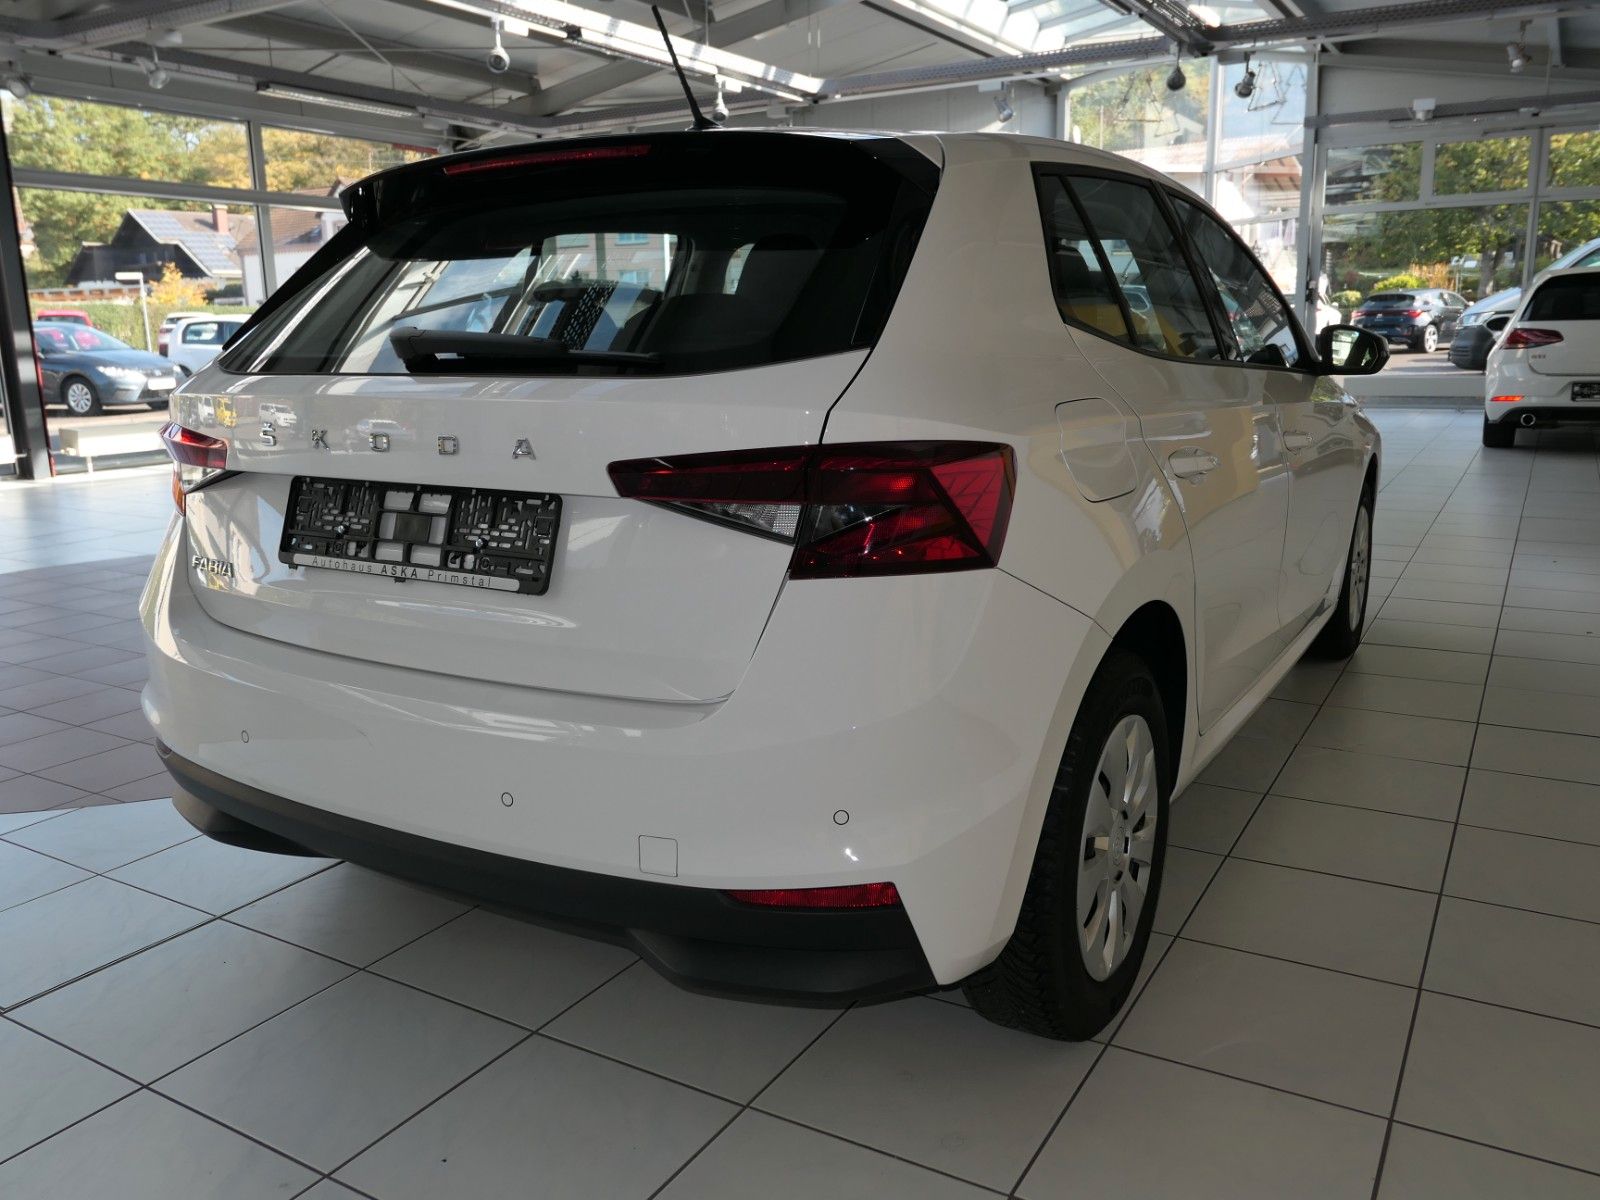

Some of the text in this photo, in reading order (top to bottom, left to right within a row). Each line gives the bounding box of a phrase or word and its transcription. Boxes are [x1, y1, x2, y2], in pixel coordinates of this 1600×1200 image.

[191, 554, 235, 578] FABIA
[312, 555, 492, 588] Autohaus ASKA Primstal
